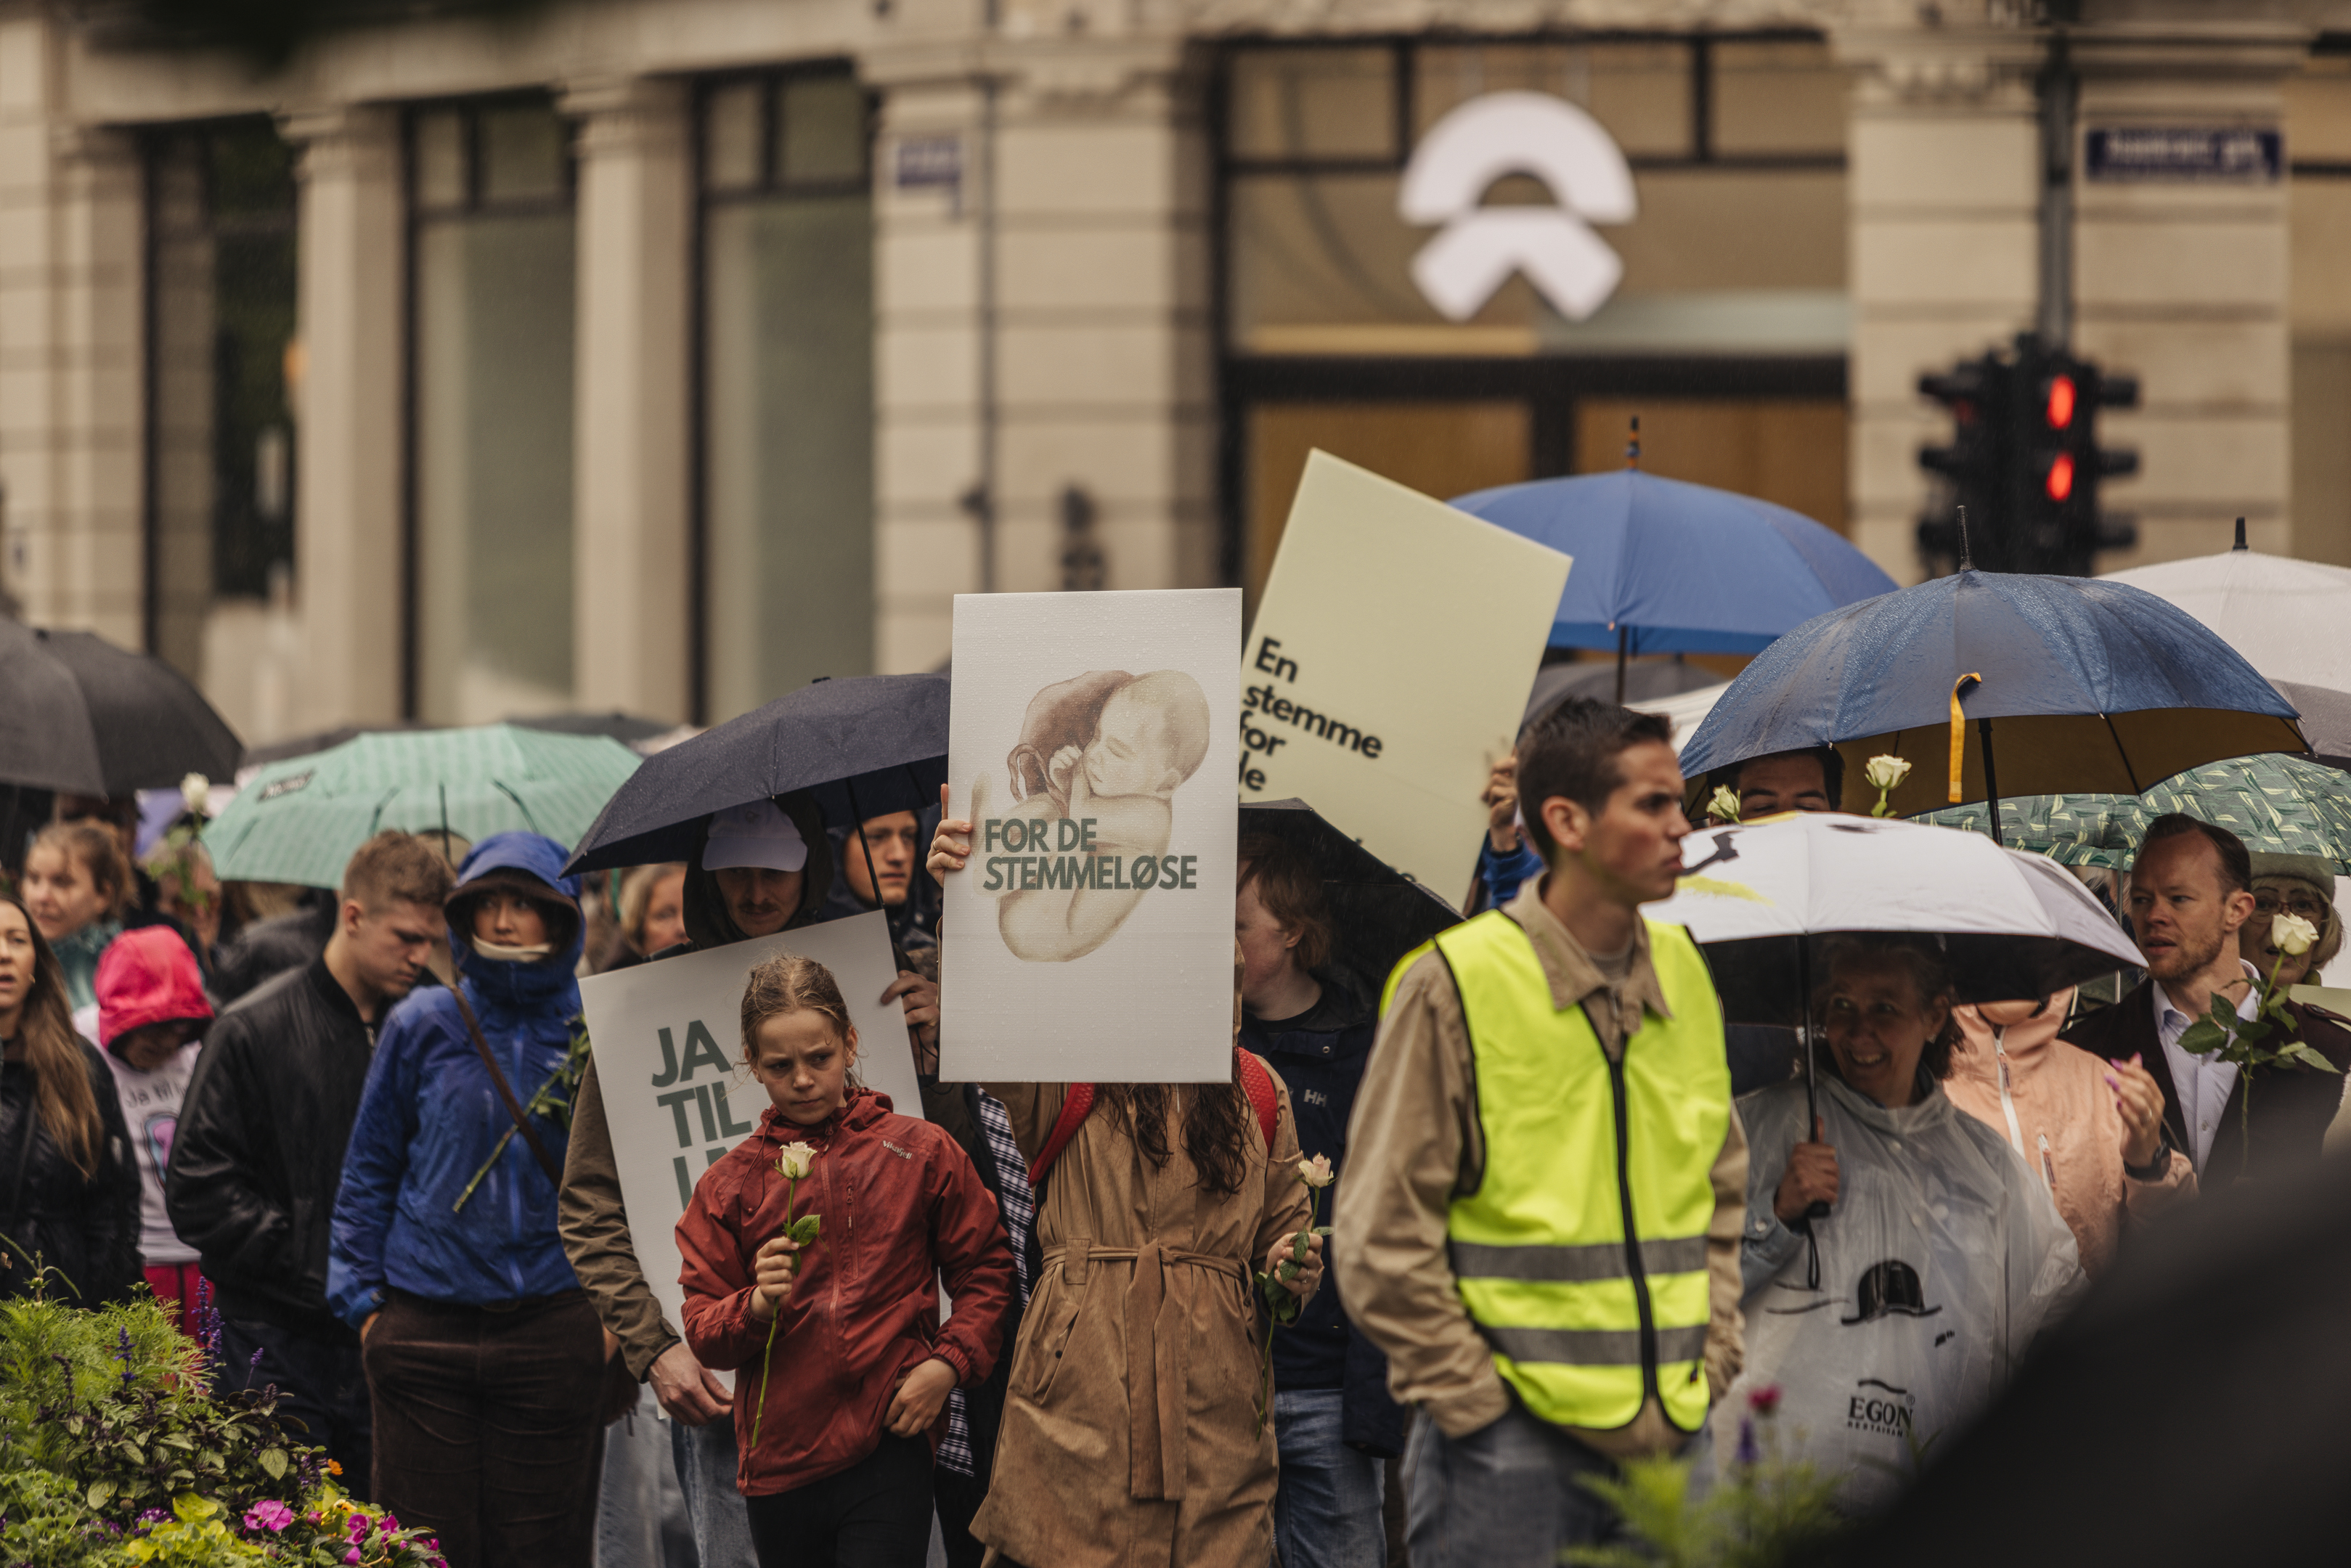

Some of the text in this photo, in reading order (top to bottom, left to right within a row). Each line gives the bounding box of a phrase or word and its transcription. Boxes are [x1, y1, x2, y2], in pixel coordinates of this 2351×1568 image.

[1254, 636, 1299, 683] En
[1239, 710, 1287, 756] for
[1242, 685, 1383, 759] stemme
[985, 818, 1097, 853] FOR DE
[982, 855, 1198, 891] STEMMELØSE
[651, 1019, 733, 1087] JA
[656, 1080, 753, 1148] TIL
[1303, 1089, 1328, 1108] HH
[882, 1140, 913, 1160] Vikafjell
[1848, 1396, 1914, 1431] EGON
